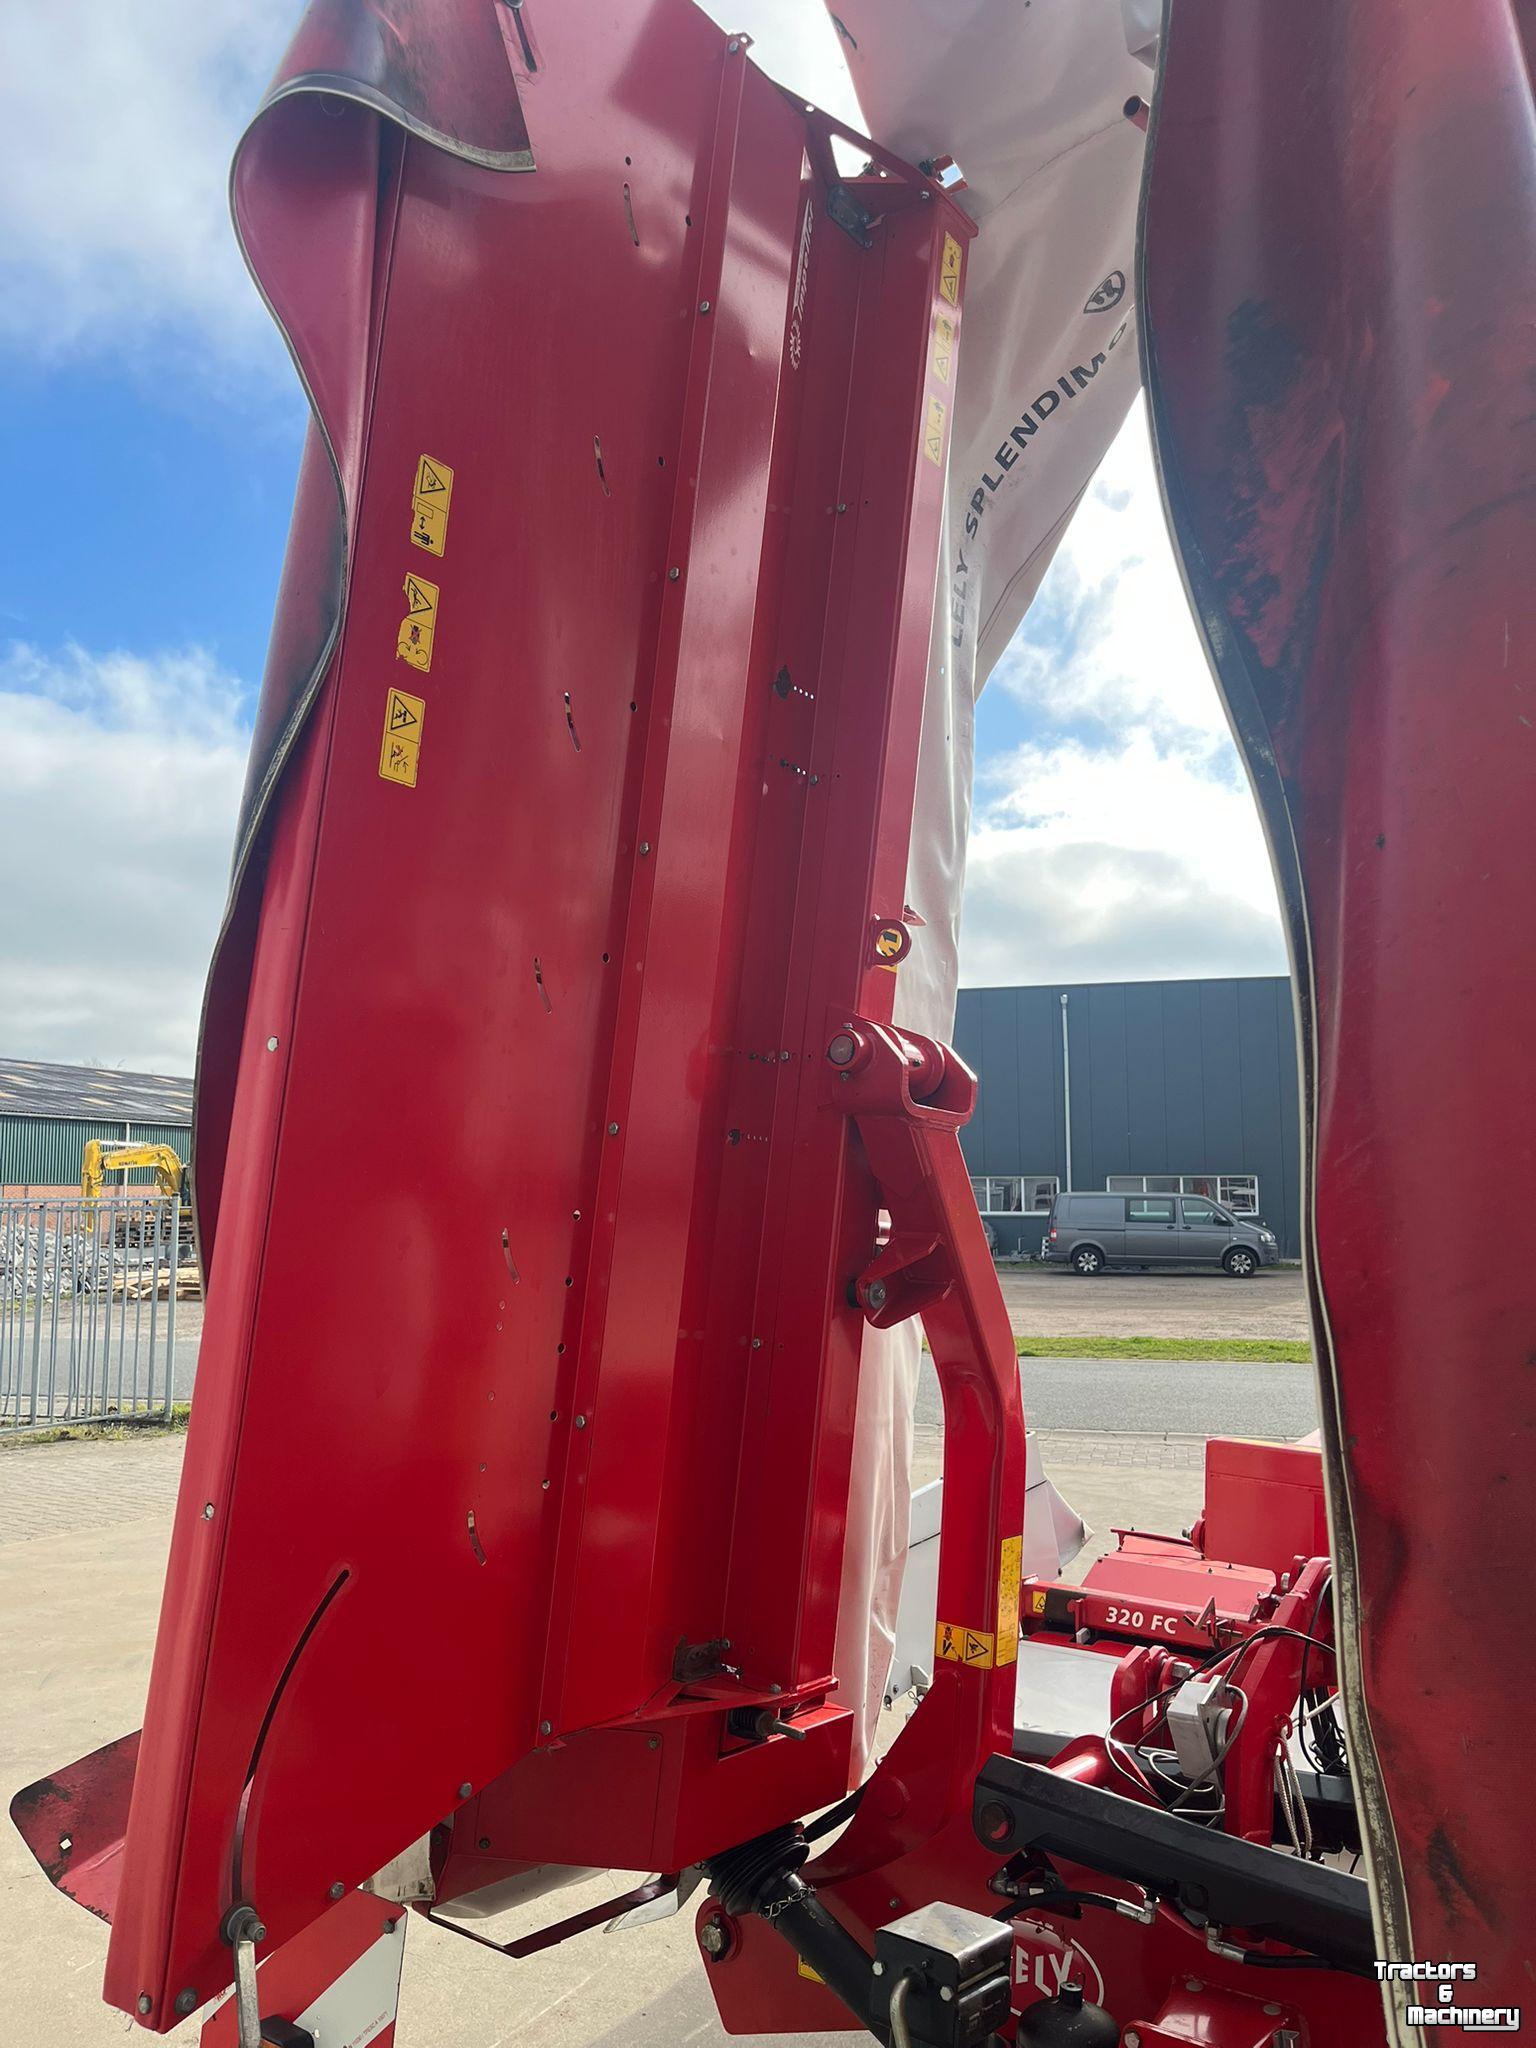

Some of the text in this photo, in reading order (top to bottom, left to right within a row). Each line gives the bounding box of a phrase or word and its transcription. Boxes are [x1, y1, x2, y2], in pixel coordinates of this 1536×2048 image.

[951, 549, 969, 648] LELY
[1105, 1606, 1178, 1635] 320 FC
[1013, 1944, 1074, 1997] ELY
